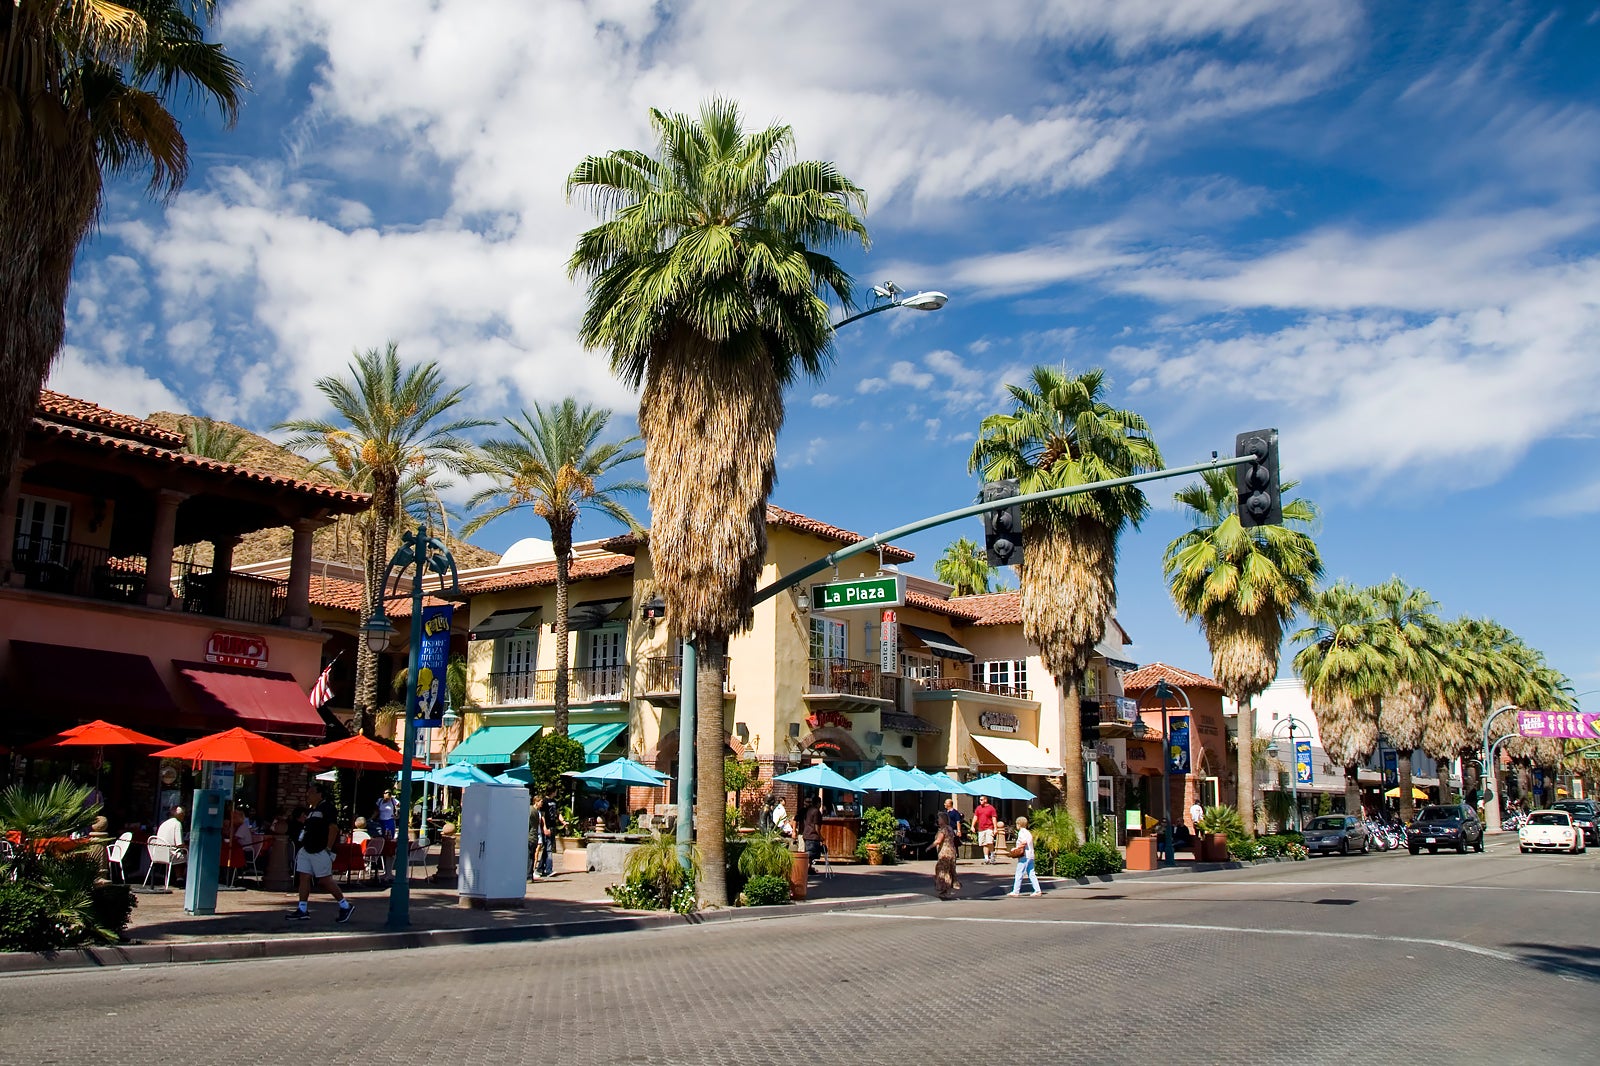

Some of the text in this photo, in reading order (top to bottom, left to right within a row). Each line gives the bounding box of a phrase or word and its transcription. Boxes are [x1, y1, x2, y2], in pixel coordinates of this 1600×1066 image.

[824, 587, 885, 603] La Plaza
[219, 656, 255, 666] DINER
